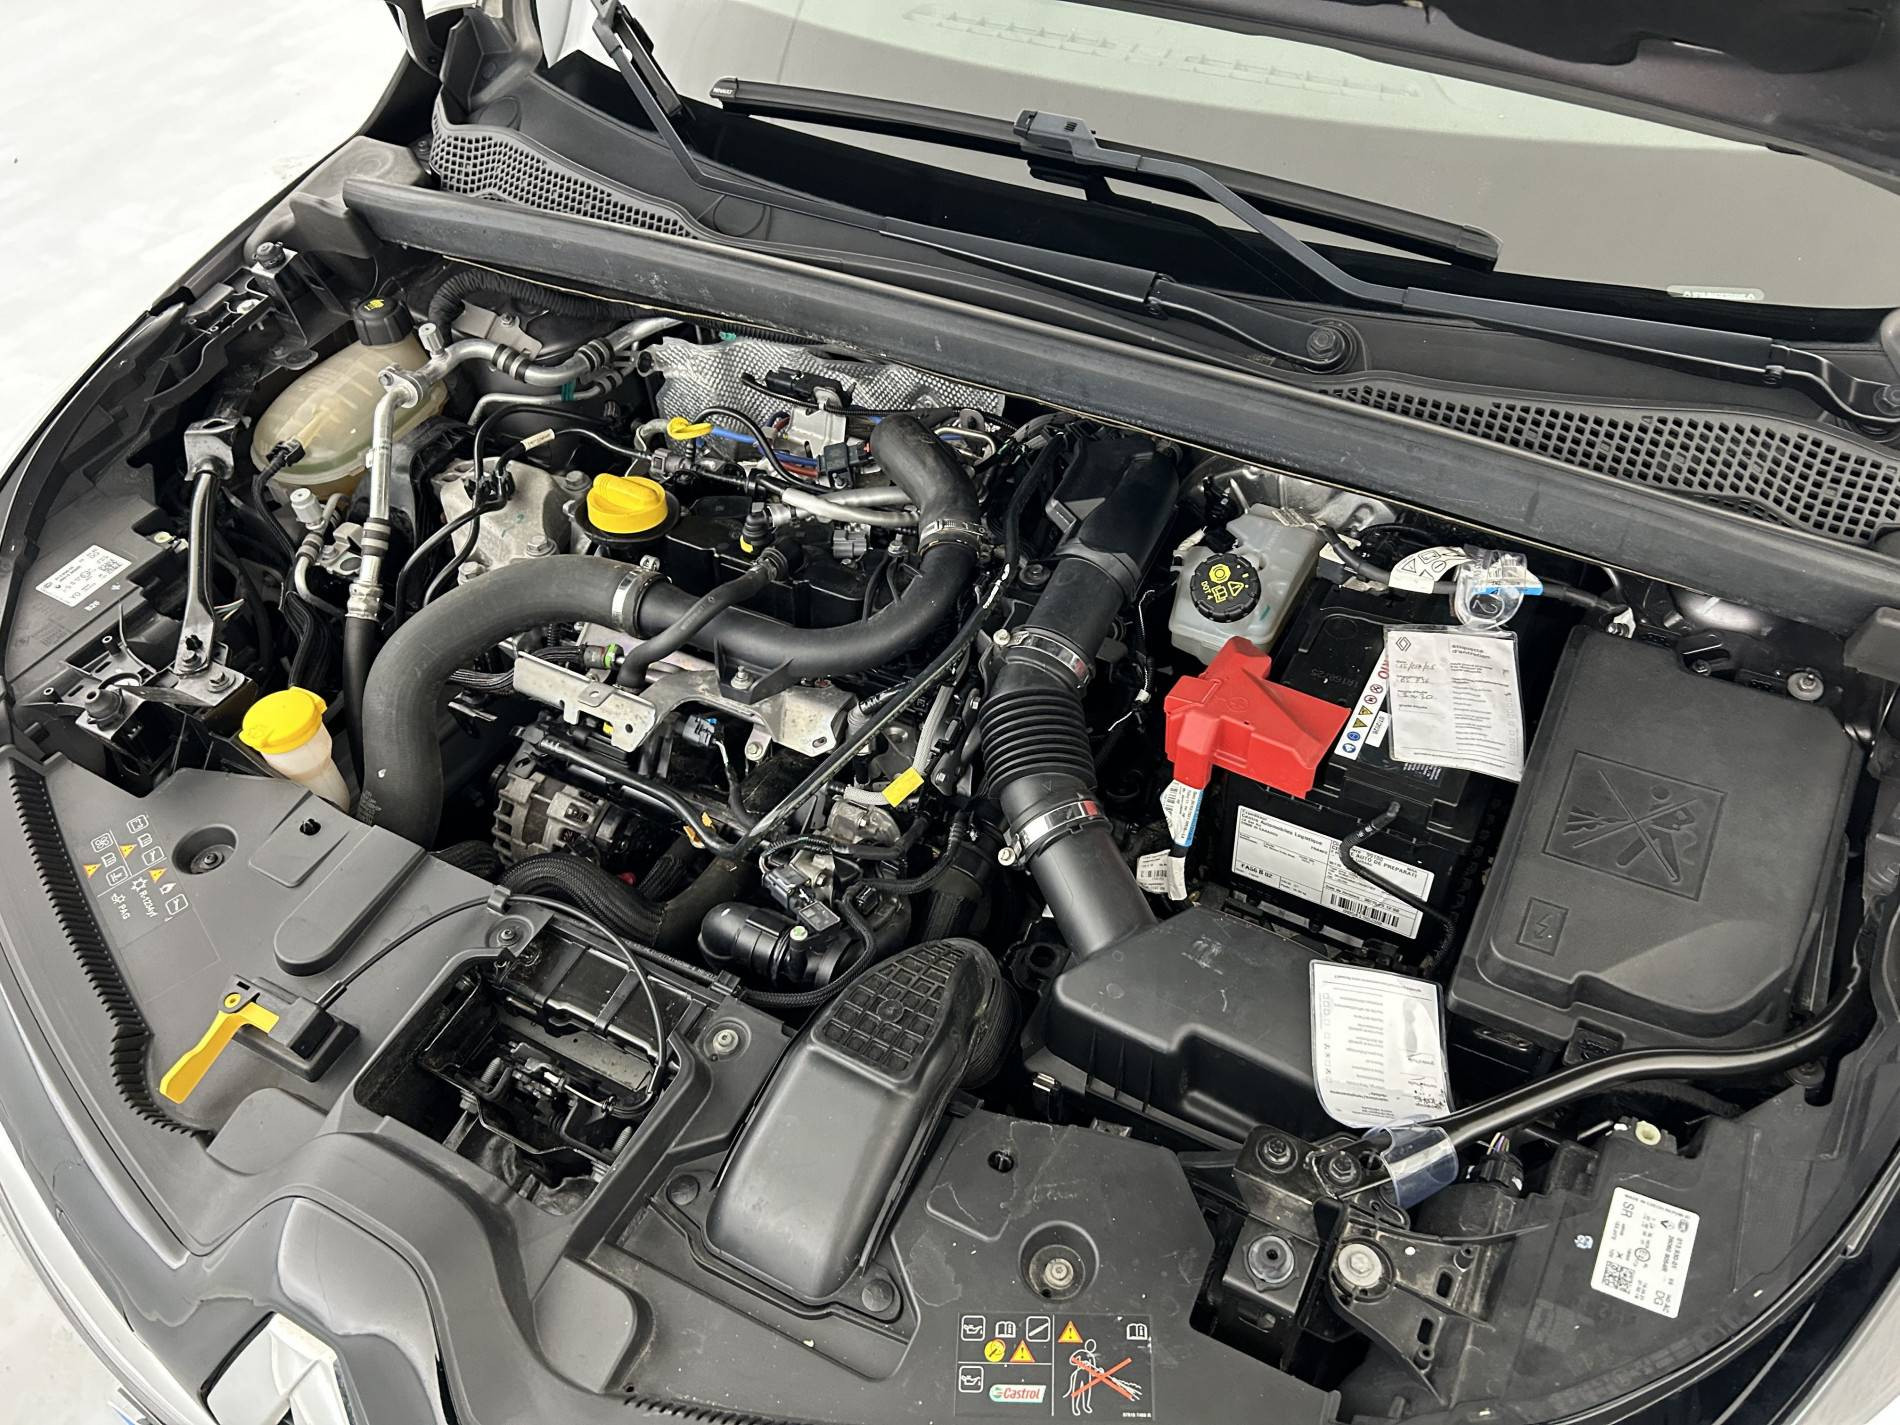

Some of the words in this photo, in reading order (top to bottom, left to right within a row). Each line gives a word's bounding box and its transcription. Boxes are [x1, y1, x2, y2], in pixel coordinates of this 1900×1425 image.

[1200, 580, 1212, 594] DOT
[1355, 852, 1372, 863] AUTO
[1373, 858, 1382, 866] DE
[117, 902, 131, 920] PAG
[1620, 1200, 1635, 1219] SR
[1653, 1290, 1666, 1306] DG
[1003, 1386, 1040, 1400] Castrol
